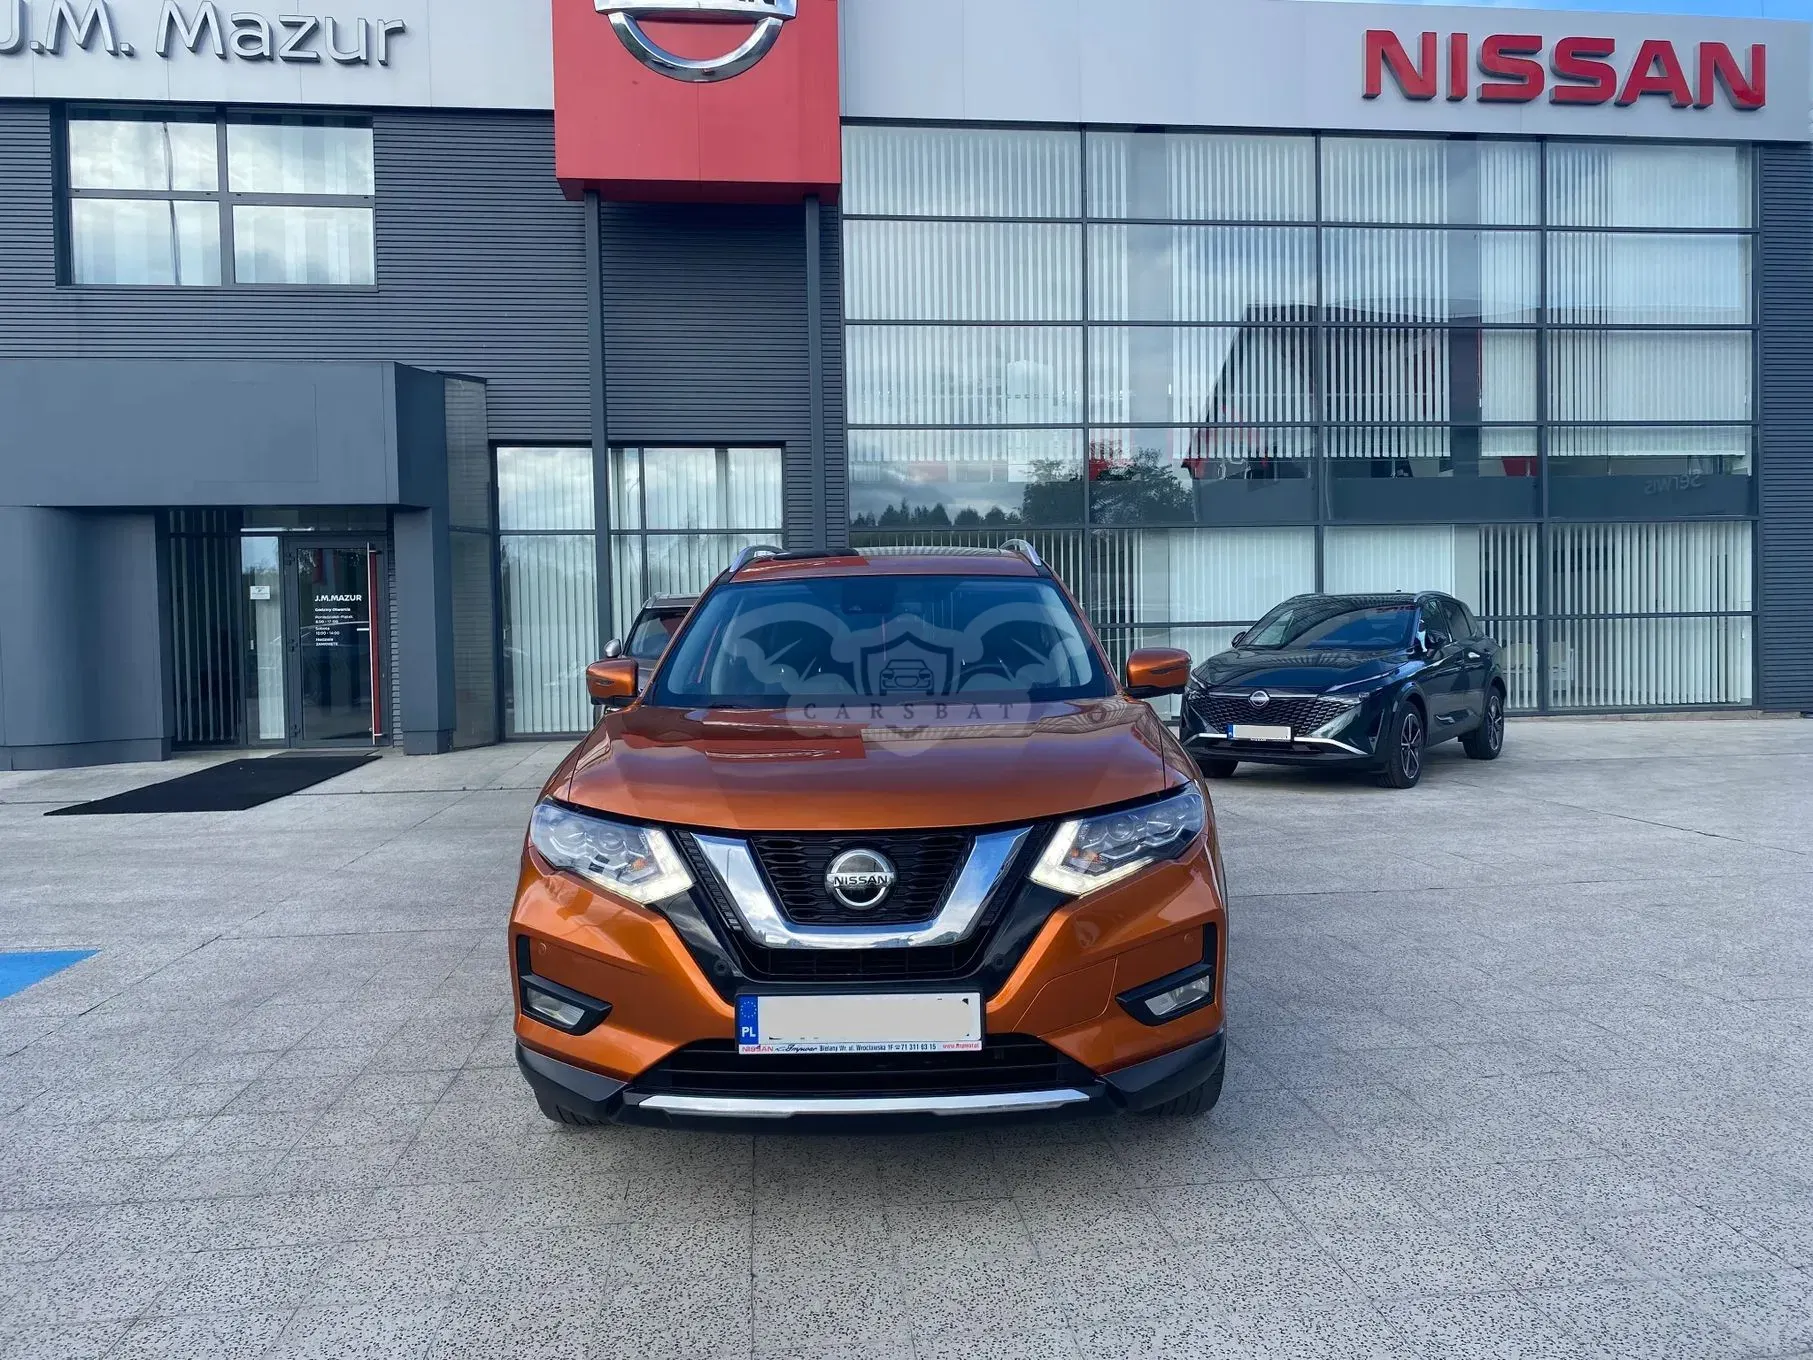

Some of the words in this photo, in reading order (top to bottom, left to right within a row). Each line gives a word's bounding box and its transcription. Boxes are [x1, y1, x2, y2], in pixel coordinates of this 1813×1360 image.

[155, 0, 406, 66] Mazur
[1362, 29, 1766, 110] NISSAN
[834, 875, 887, 885] NISSAN
[741, 1026, 756, 1037] PL
